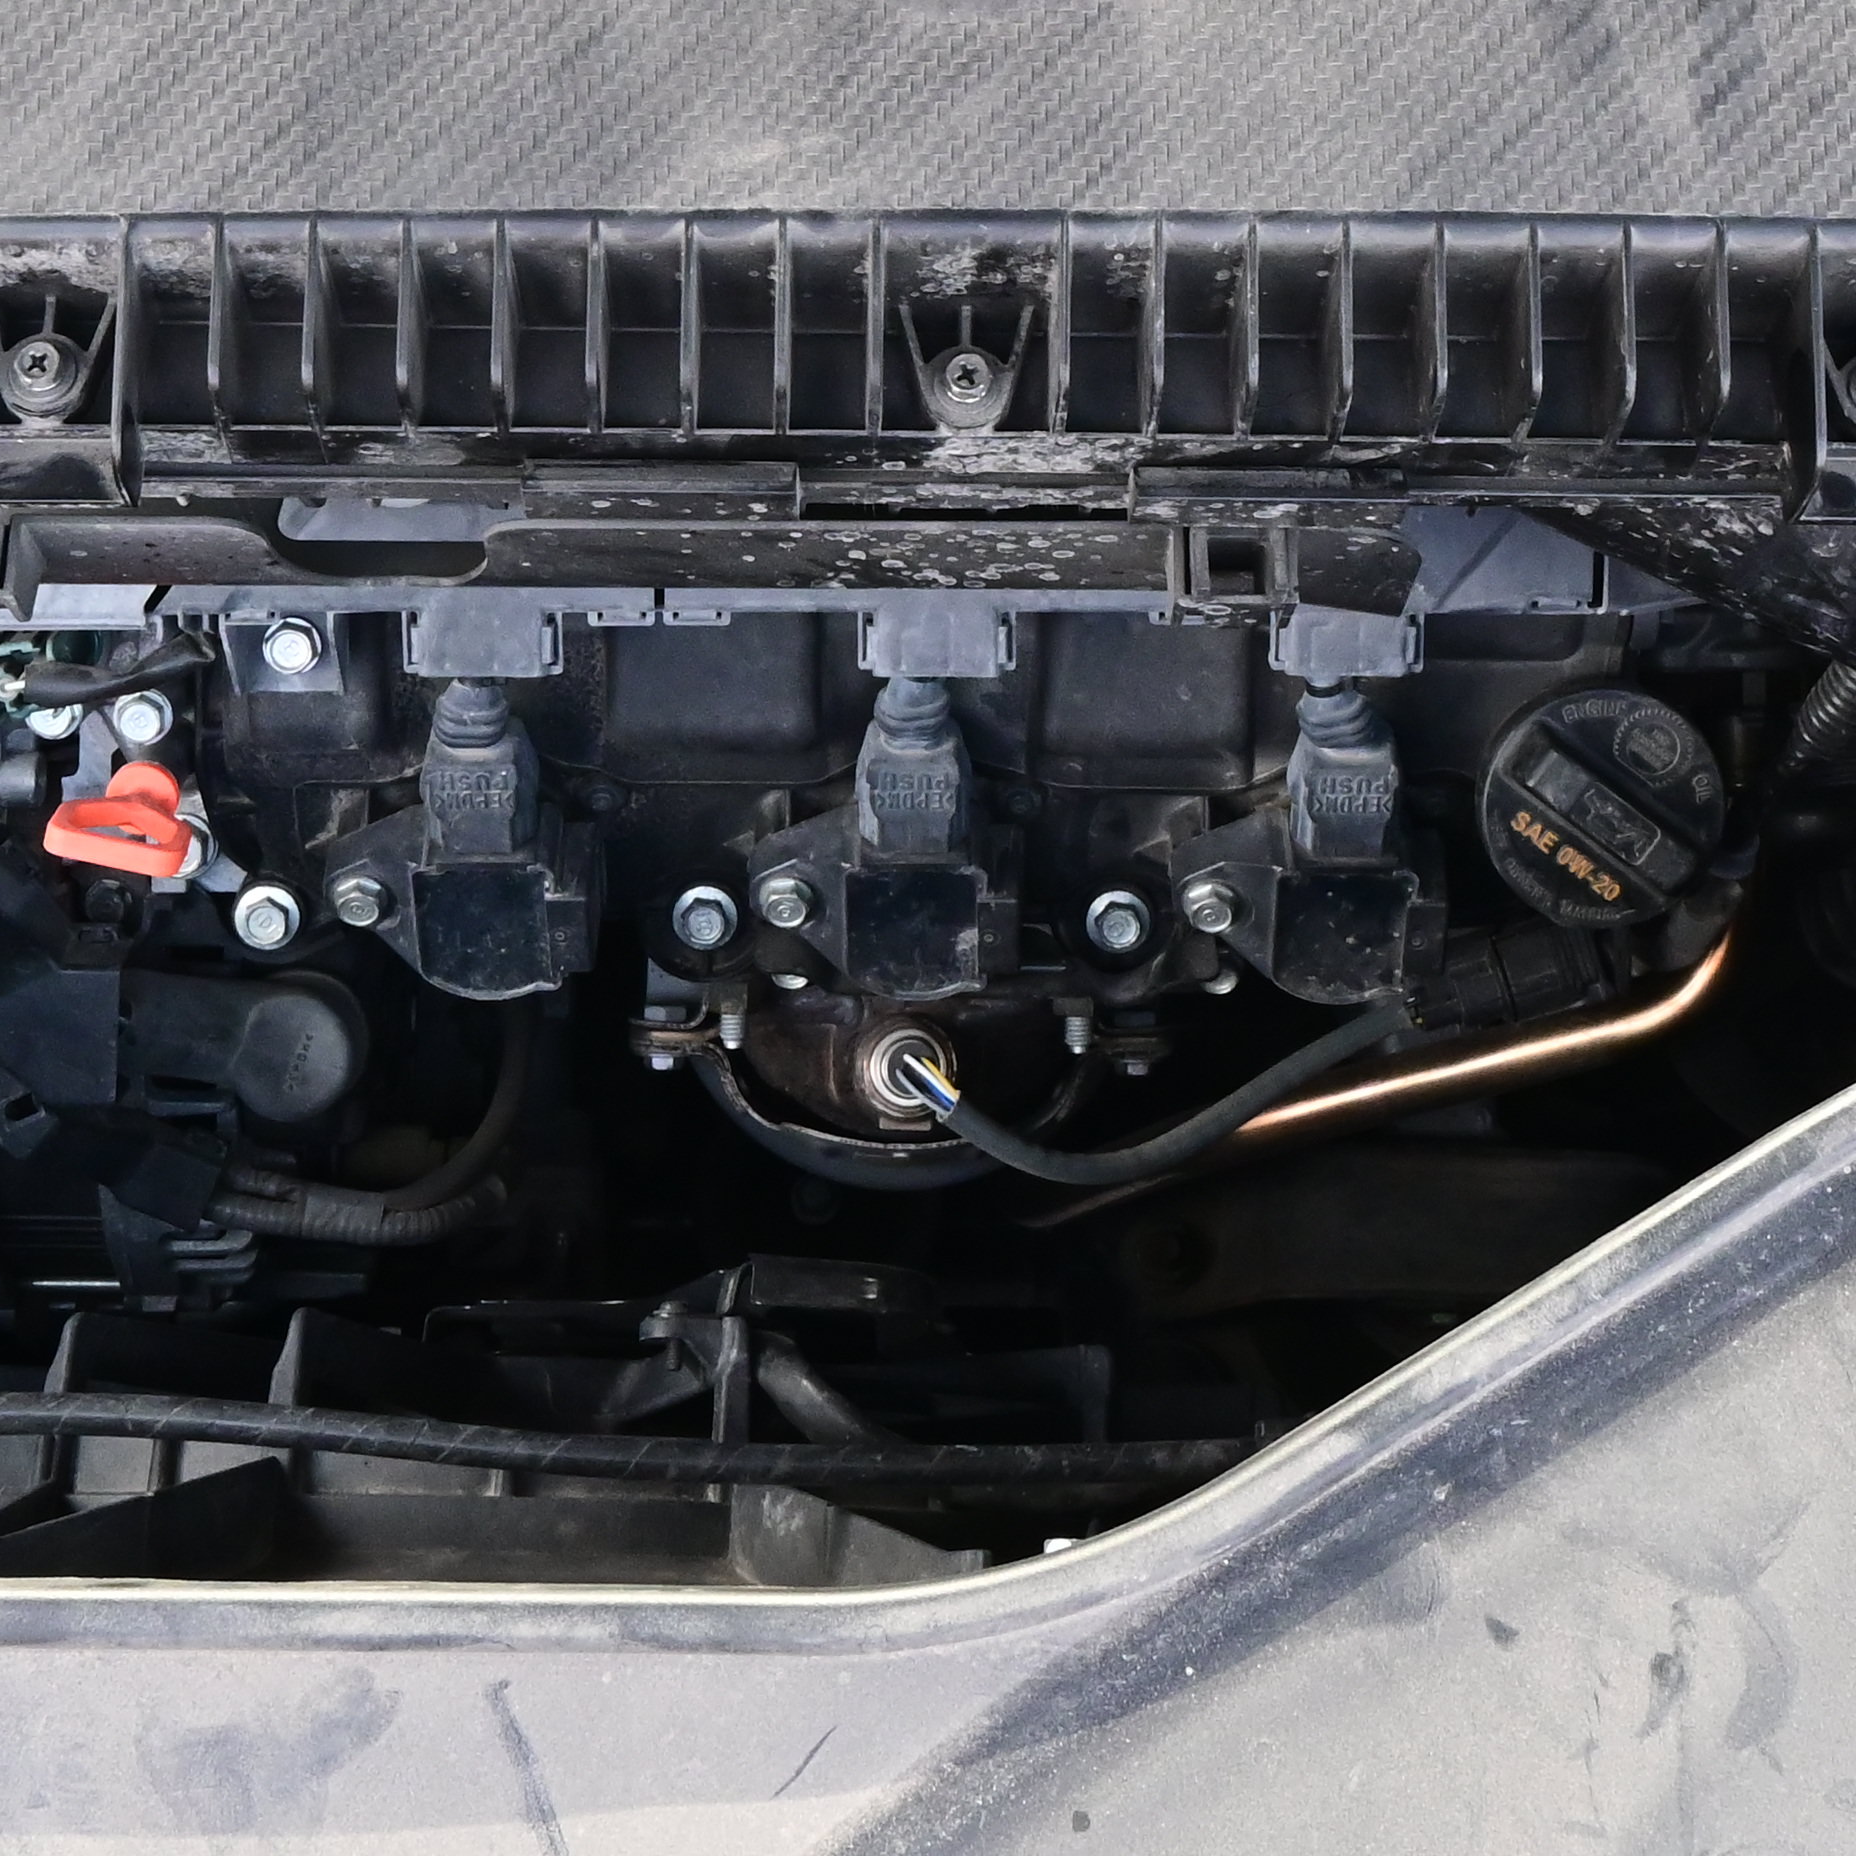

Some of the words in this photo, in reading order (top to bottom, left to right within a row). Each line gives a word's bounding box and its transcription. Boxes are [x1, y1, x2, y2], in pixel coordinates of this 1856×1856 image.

[1561, 699, 1629, 722] ENGINE
[439, 771, 510, 791] PUSH
[879, 772, 950, 791] PUSH
[1319, 775, 1390, 794] PUSH
[1691, 774, 1713, 804] OIL
[1510, 810, 1560, 855] SAE
[1555, 844, 1623, 902] 0W-20
